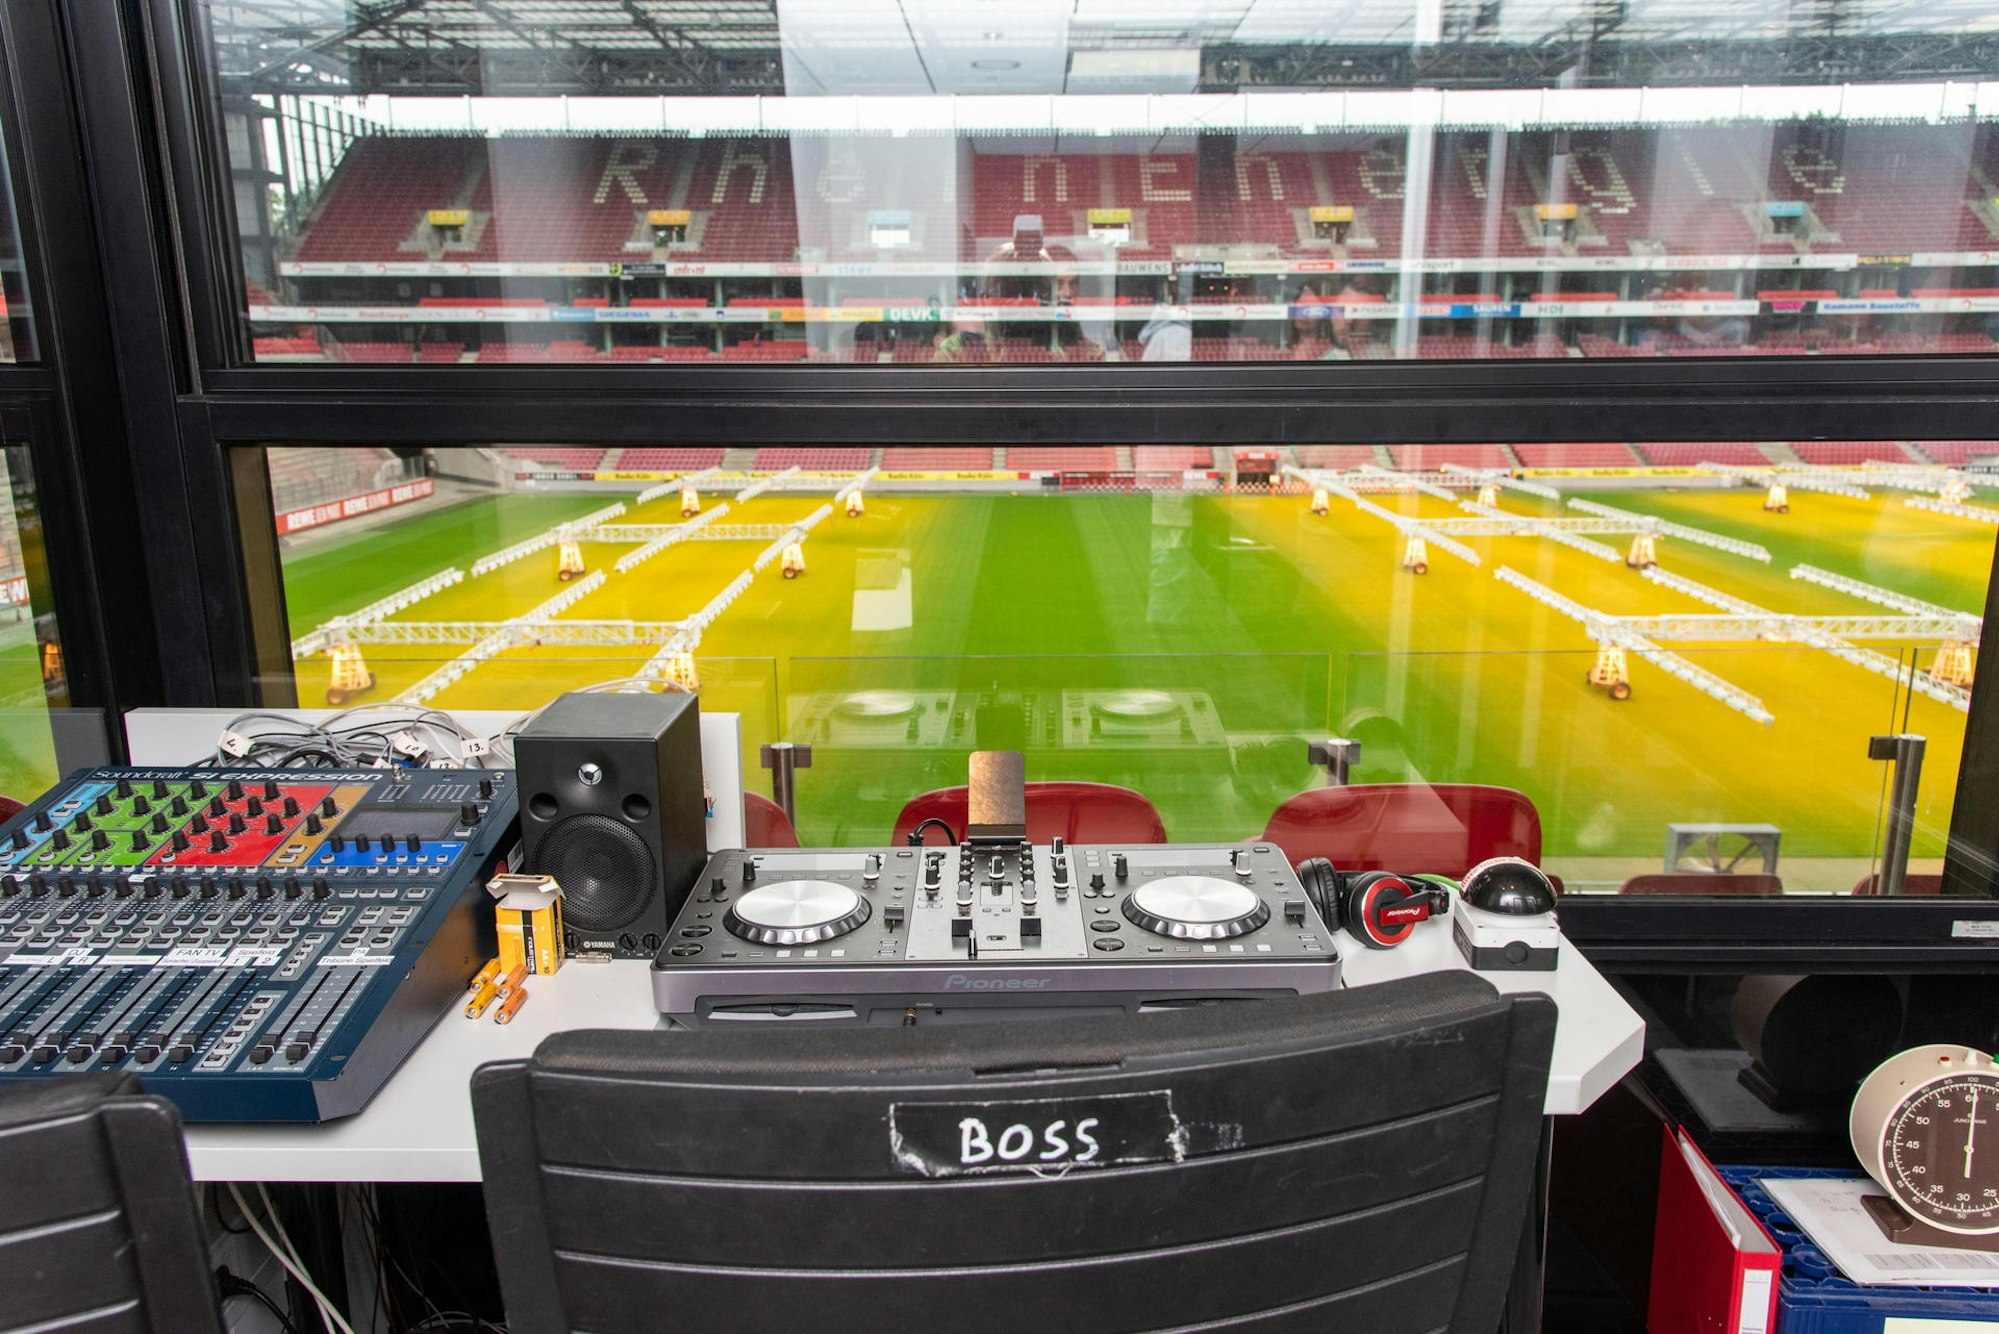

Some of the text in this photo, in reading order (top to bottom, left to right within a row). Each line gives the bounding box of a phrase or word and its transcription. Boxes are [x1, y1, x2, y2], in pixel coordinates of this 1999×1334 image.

[890, 308, 932, 321] DEVK
[590, 941, 616, 949] YAMAHA
[943, 974, 1051, 989] Pioneer
[1937, 1100, 1951, 1108] 55
[1915, 1117, 1930, 1125] 50
[958, 1117, 1099, 1163] BOSS
[1906, 1140, 1920, 1149] 45
[1912, 1165, 1926, 1174] 40
[1930, 1184, 1944, 1193] 35
[1983, 1188, 1997, 1197] 25
[1956, 1193, 1971, 1201] 30
